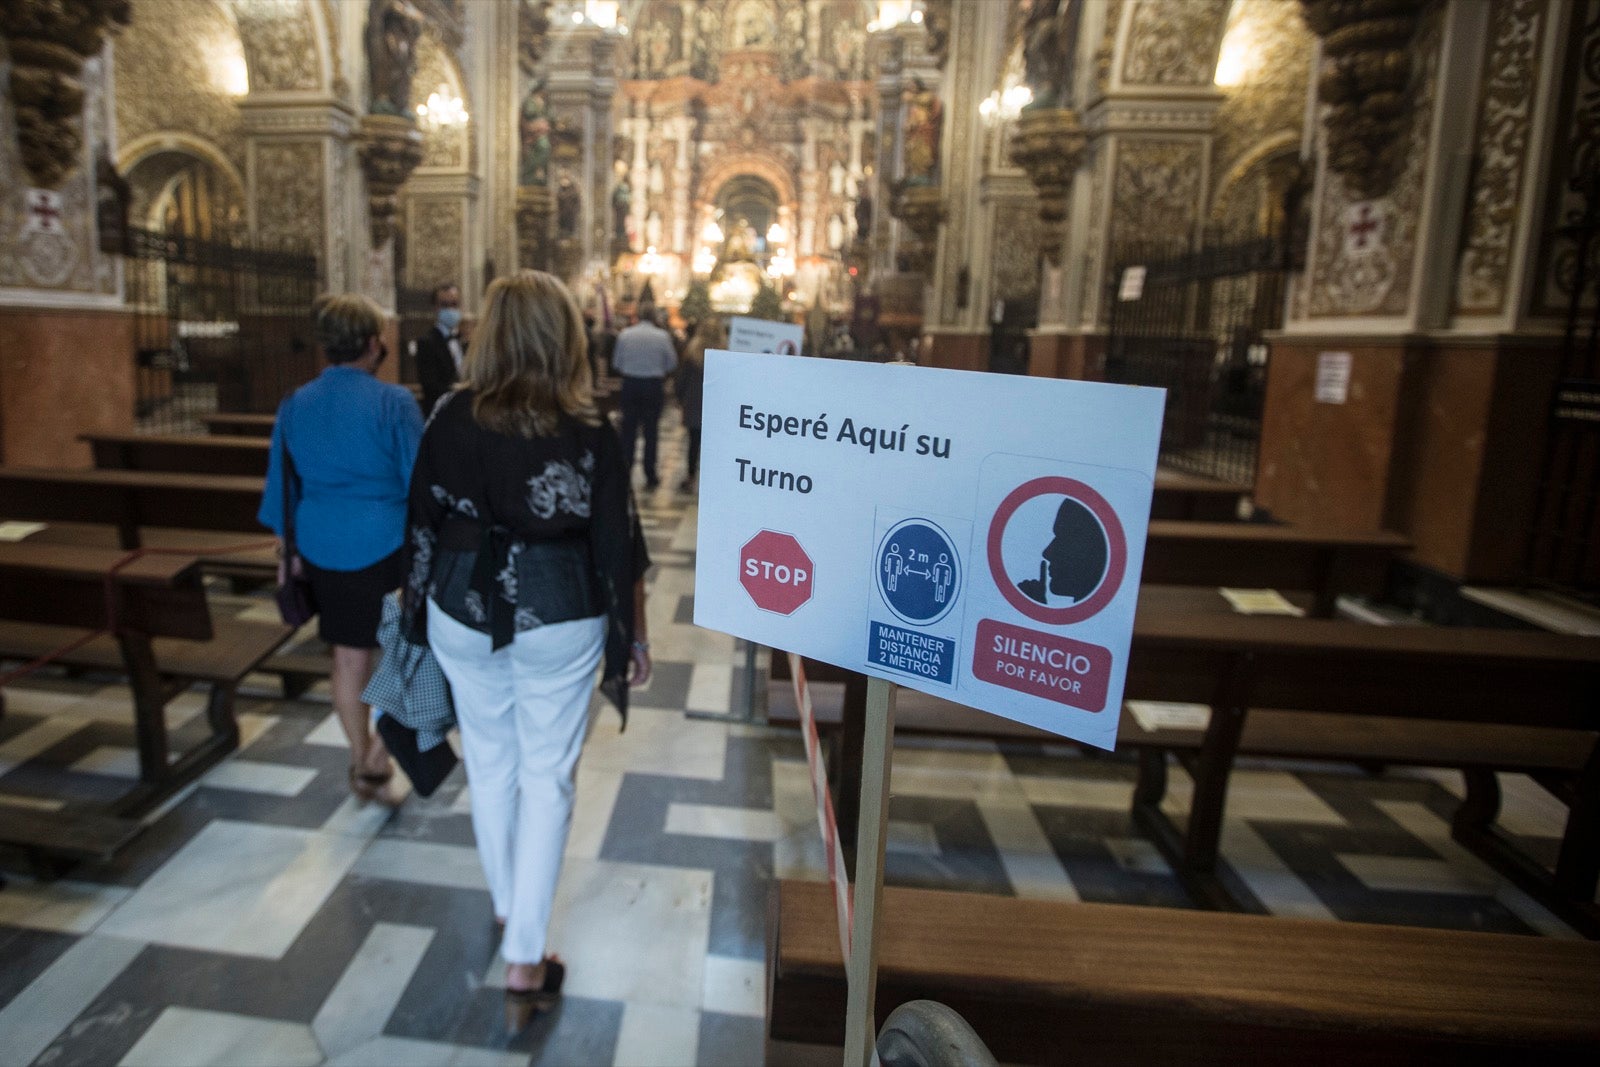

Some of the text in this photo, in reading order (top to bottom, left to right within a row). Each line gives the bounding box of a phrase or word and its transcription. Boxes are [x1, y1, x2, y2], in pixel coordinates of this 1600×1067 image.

[739, 404, 951, 458] Esperé Aquí su
[735, 458, 813, 494] Turno
[908, 548, 929, 563] 2 m
[745, 558, 807, 586] STOP
[879, 626, 944, 653] MANTENER
[880, 639, 941, 665] DISTANCIA
[880, 652, 938, 677] 2 METROS
[992, 634, 1091, 675] SILENCIO
[996, 660, 1081, 694] POR FAVOR
